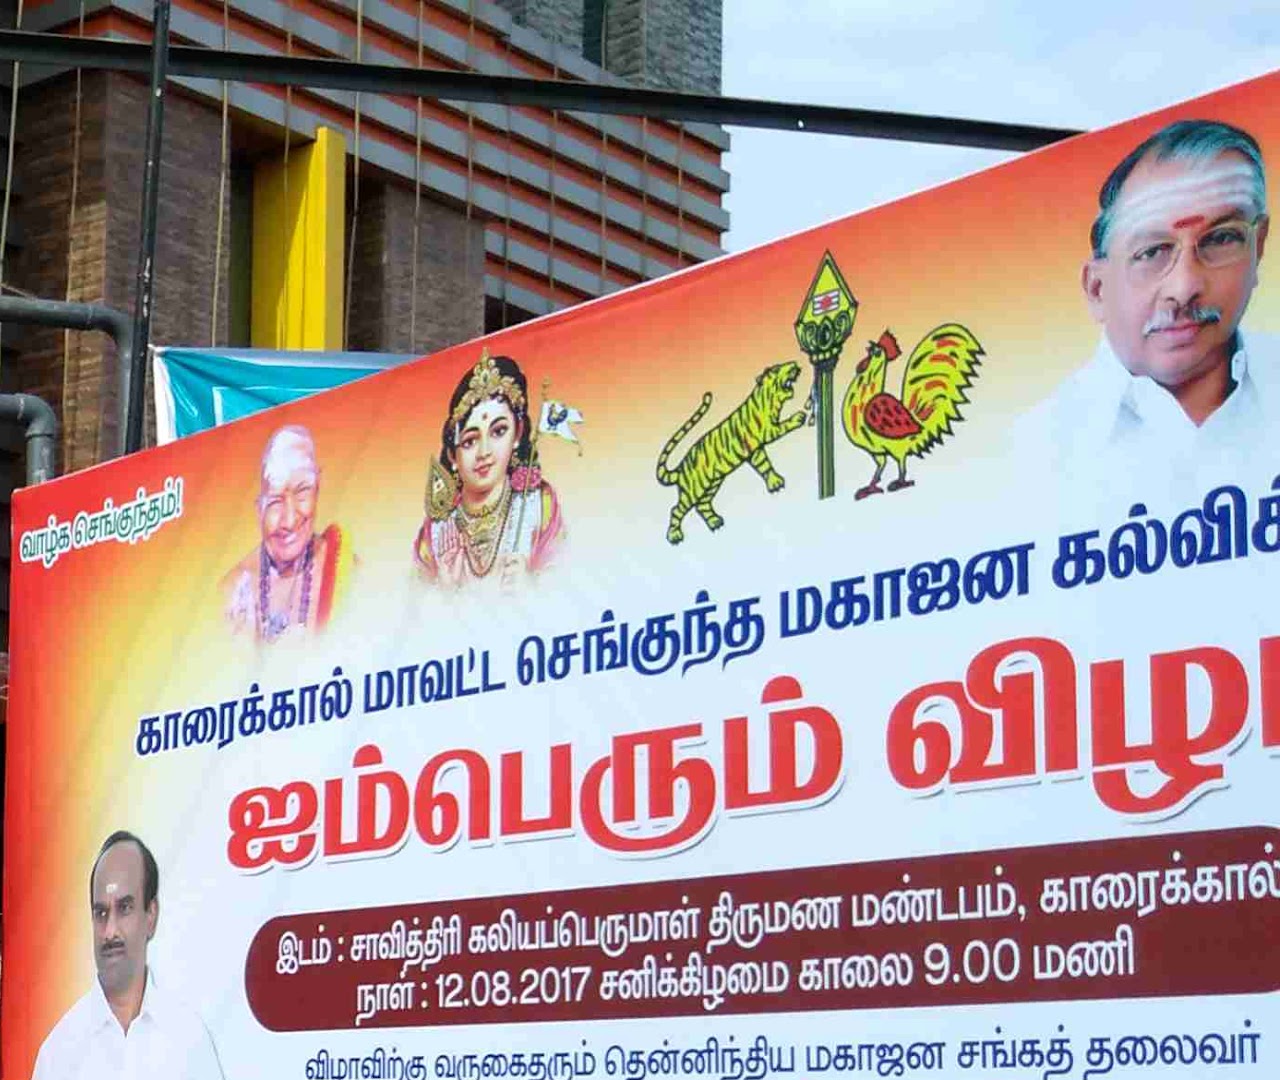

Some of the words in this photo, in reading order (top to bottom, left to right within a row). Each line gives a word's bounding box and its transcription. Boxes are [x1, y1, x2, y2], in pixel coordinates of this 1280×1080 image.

[20, 512, 71, 564] வாழ்க
[73, 480, 182, 549] செங்குந்தம்!
[136, 666, 351, 756] காரைக்கால்
[363, 647, 507, 712] மாவட்ட
[517, 590, 765, 679] செங்குந்த
[779, 541, 1036, 639] மகாஜன
[227, 675, 845, 870] ஐம்பெரும்
[885, 635, 1280, 815] விழ
[276, 926, 332, 976] இடம்
[349, 914, 462, 971] சாவித்திரி
[707, 891, 842, 948] திருமண
[851, 865, 1027, 929] மண்டபம்,
[355, 972, 414, 1026] நாள்
[435, 966, 592, 1011] 12.08.2017
[599, 952, 788, 1012] சனிக்கிழமை
[799, 951, 913, 992] காலை
[923, 938, 1020, 986] 9.00
[1033, 923, 1136, 982] மணி
[806, 1040, 946, 1077] மகாஜன
